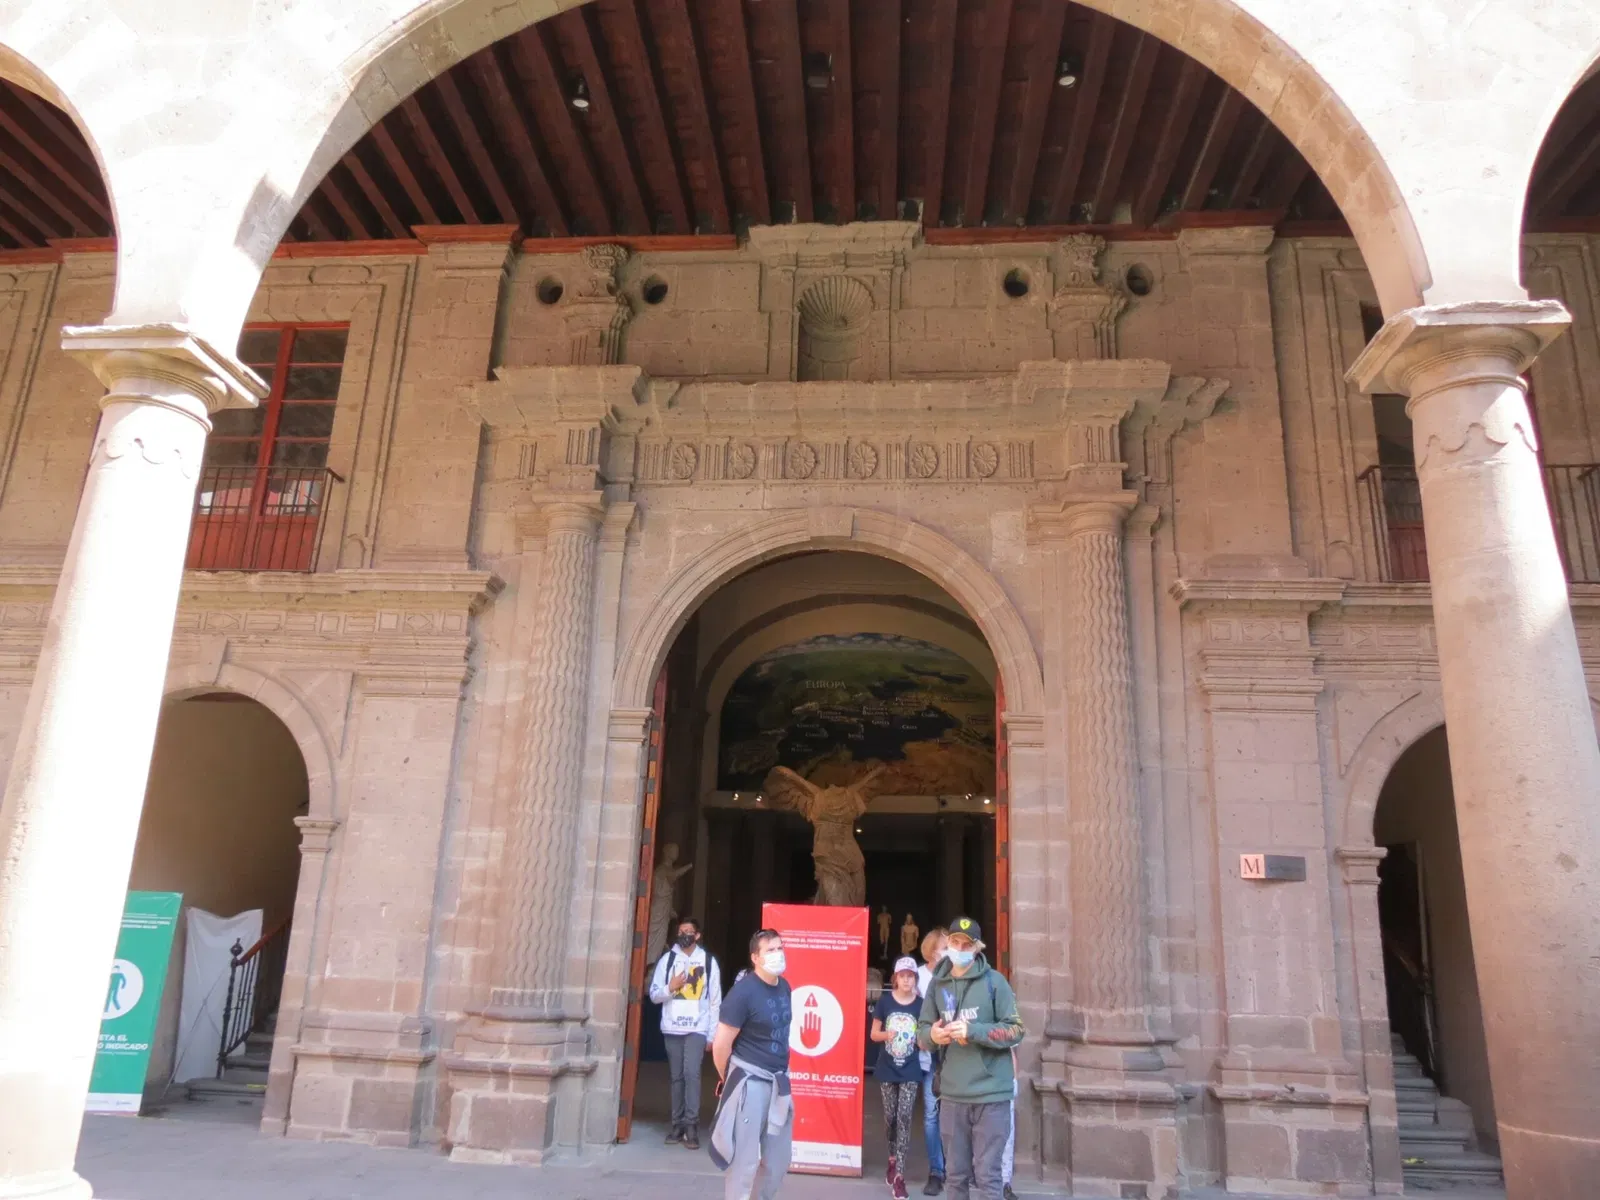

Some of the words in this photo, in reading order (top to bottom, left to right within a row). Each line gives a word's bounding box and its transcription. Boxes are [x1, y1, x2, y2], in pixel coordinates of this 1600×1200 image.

[805, 680, 847, 690] EUROPA
[1243, 858, 1260, 874] M
[811, 1073, 821, 1081] EL
[823, 1075, 860, 1084] ACCESO
